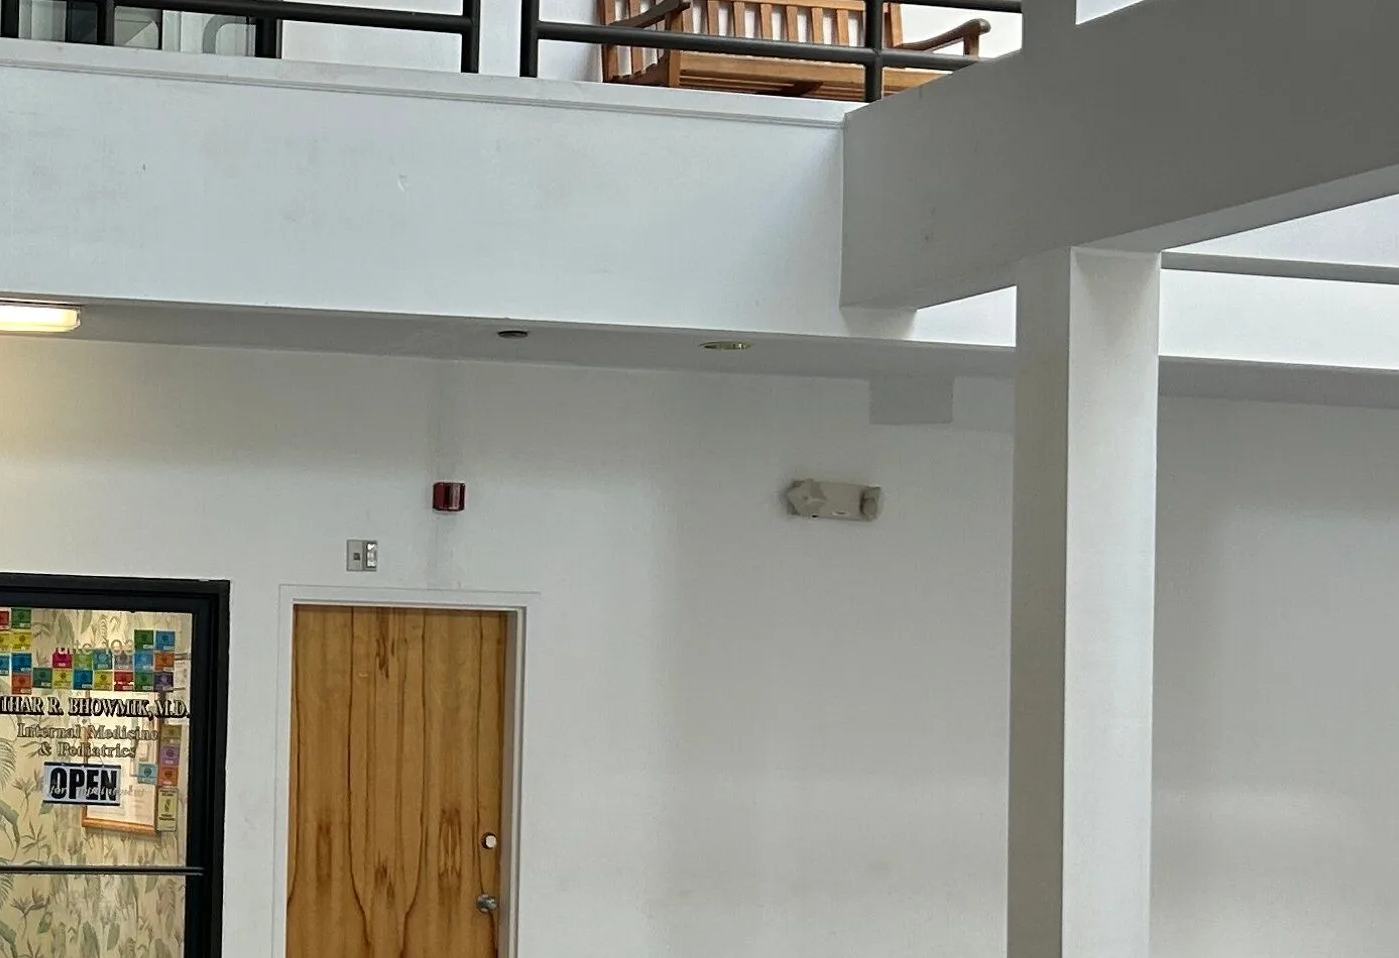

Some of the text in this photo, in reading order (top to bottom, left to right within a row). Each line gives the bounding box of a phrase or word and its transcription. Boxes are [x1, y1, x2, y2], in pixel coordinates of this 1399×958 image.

[47, 696, 64, 715] R.
[68, 697, 153, 720] BHOWMIK,
[154, 699, 191, 718] M.D.
[16, 722, 160, 741] Internal Medicine
[38, 741, 137, 758] & Pediatrics
[49, 767, 118, 801] OPEN
